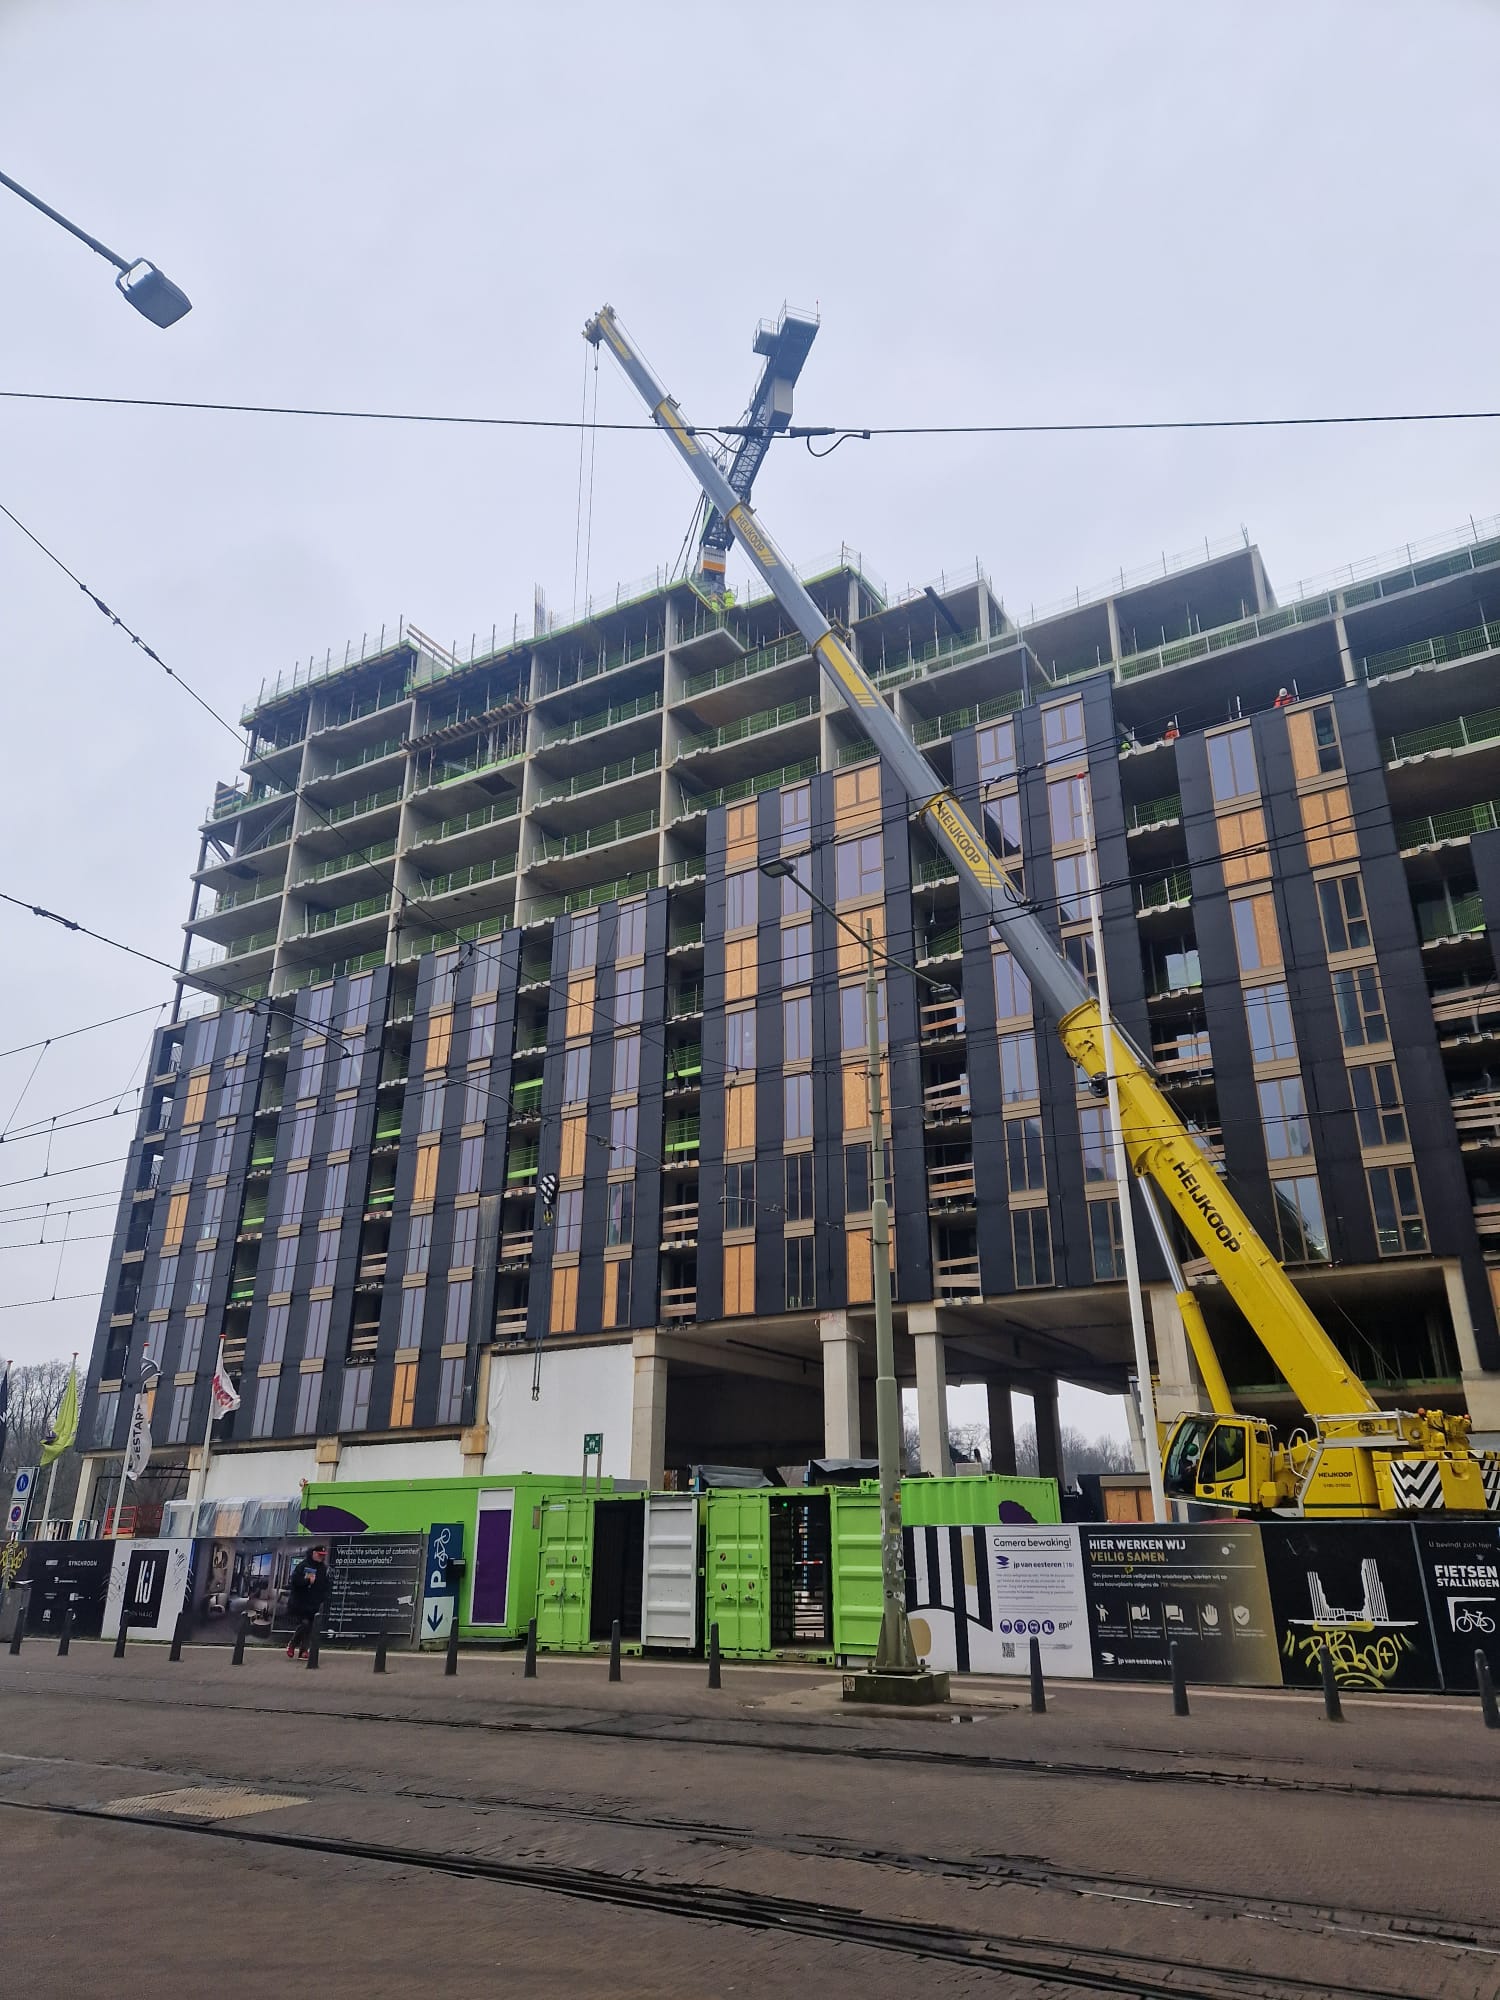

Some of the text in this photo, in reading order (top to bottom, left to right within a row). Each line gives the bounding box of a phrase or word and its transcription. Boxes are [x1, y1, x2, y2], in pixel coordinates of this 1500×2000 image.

[736, 514, 765, 551] HEIJKOOP
[939, 806, 981, 864] HEIJKOOP
[1172, 1161, 1240, 1252] HEIJKOOP
[1318, 1471, 1353, 1479] HEIJKOOP
[993, 1537, 1071, 1549] Camera bewaking!
[1089, 1540, 1186, 1550] HIER WERKEN WIJ
[1090, 1551, 1169, 1562] VEILIG SAMEN.
[1013, 1561, 1020, 1569] jp
[1434, 1565, 1498, 1578] FIETSEN
[430, 1570, 447, 1588] P
[1437, 1578, 1500, 1588] STALLINGEN
